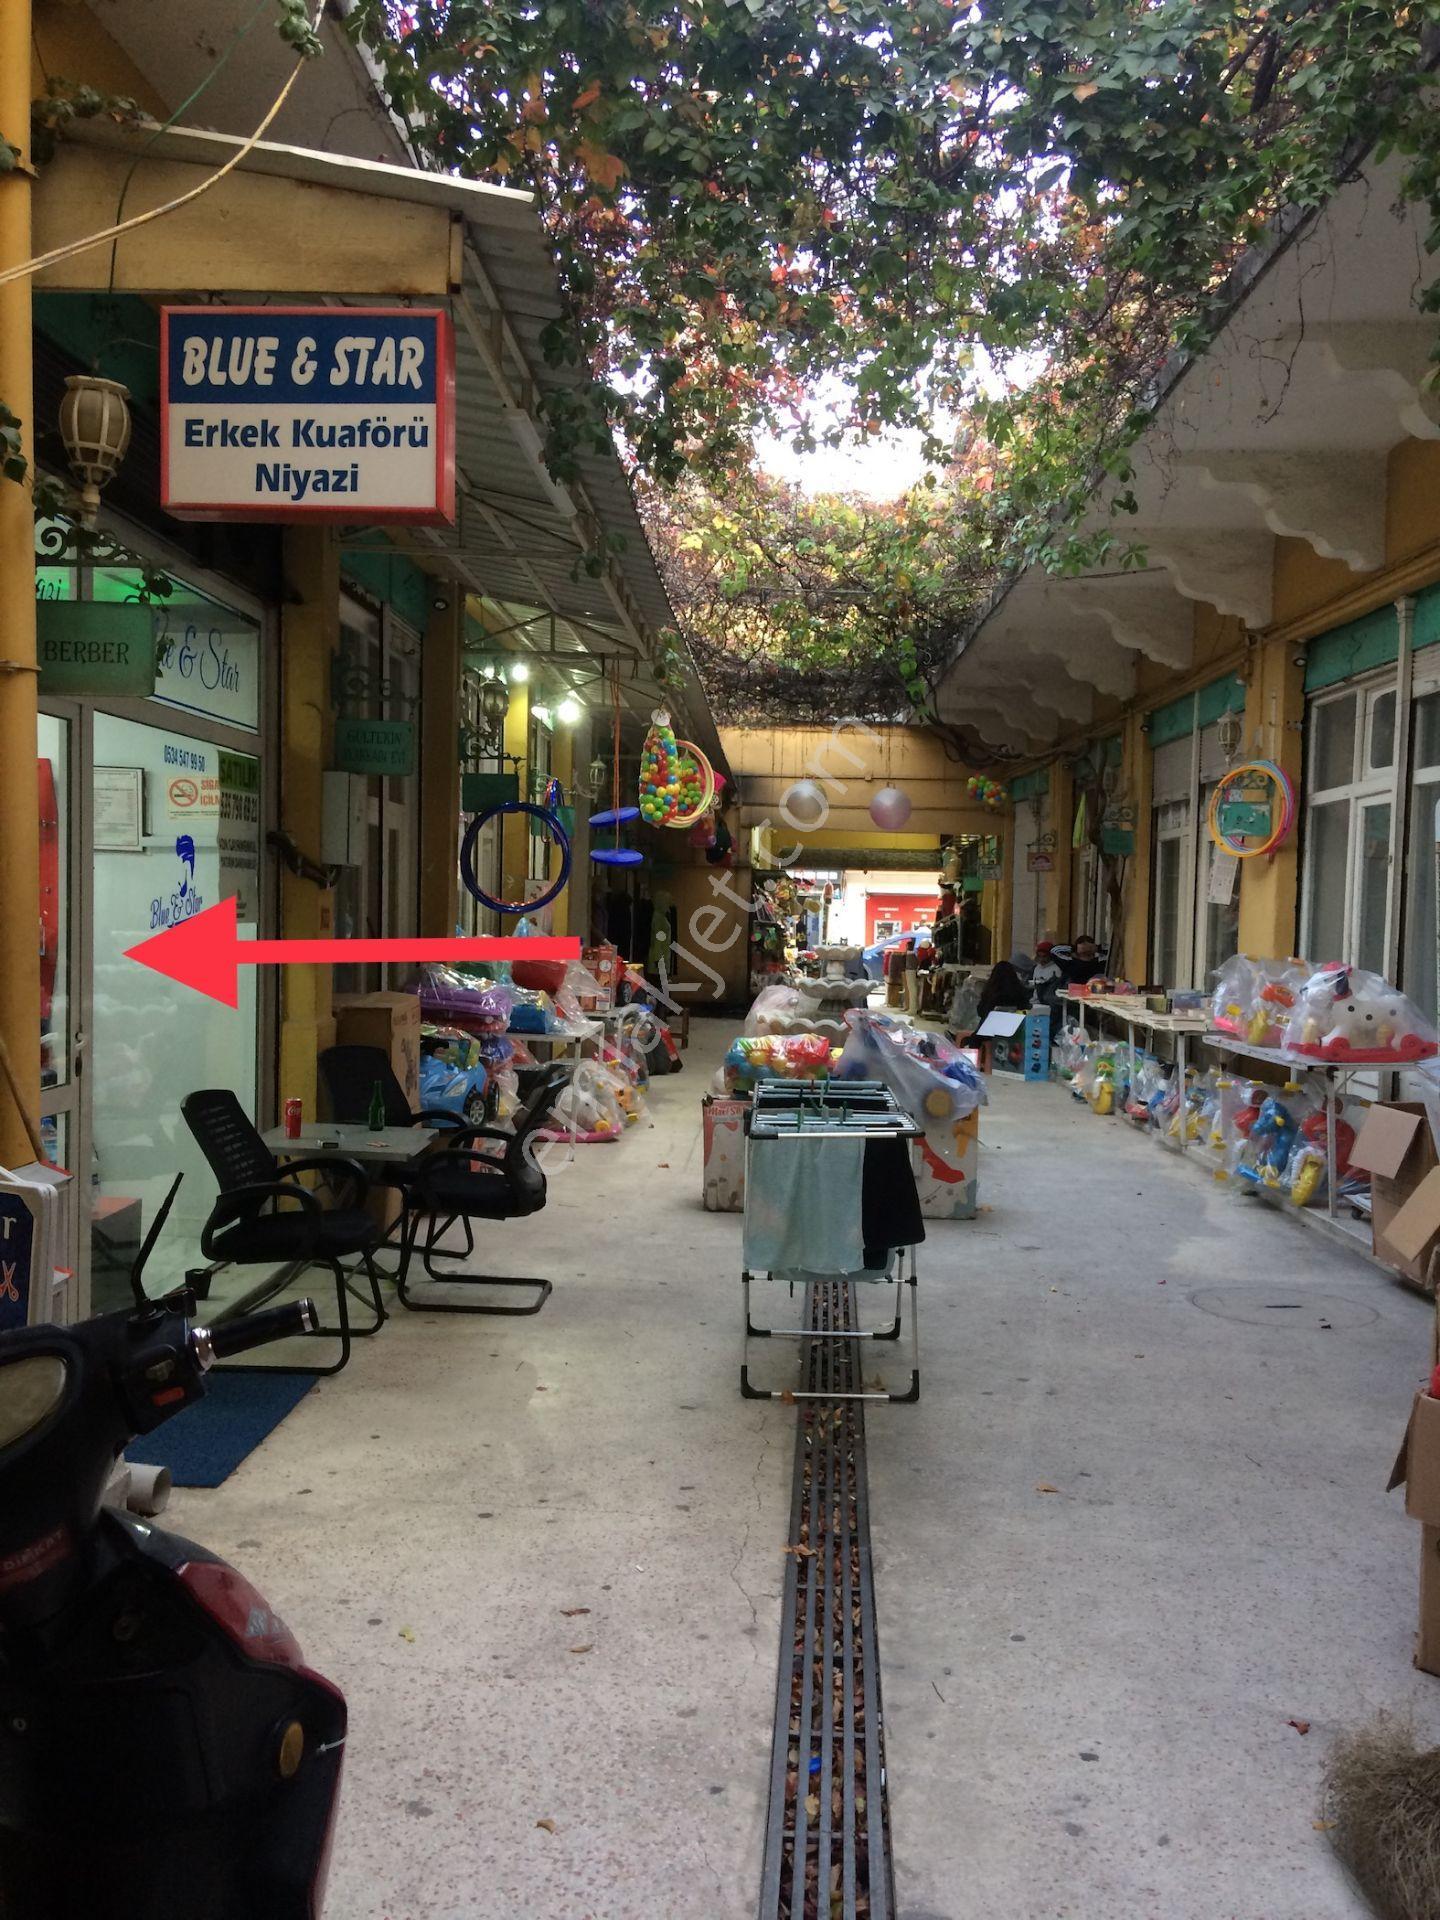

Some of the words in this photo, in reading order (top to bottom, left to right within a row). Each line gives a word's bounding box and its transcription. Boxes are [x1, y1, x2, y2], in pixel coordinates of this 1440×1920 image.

[182, 336, 279, 386] BLUE
[291, 336, 318, 386] &
[329, 336, 425, 389] STAR
[184, 418, 280, 448] Erkek
[292, 416, 429, 448] Kuaförü
[255, 463, 359, 501] Niyazi
[44, 640, 129, 664] BERBER
[200, 628, 239, 692] Star
[164, 744, 178, 765] 0534
[179, 749, 190, 768] 547
[150, 896, 170, 929] Blue
